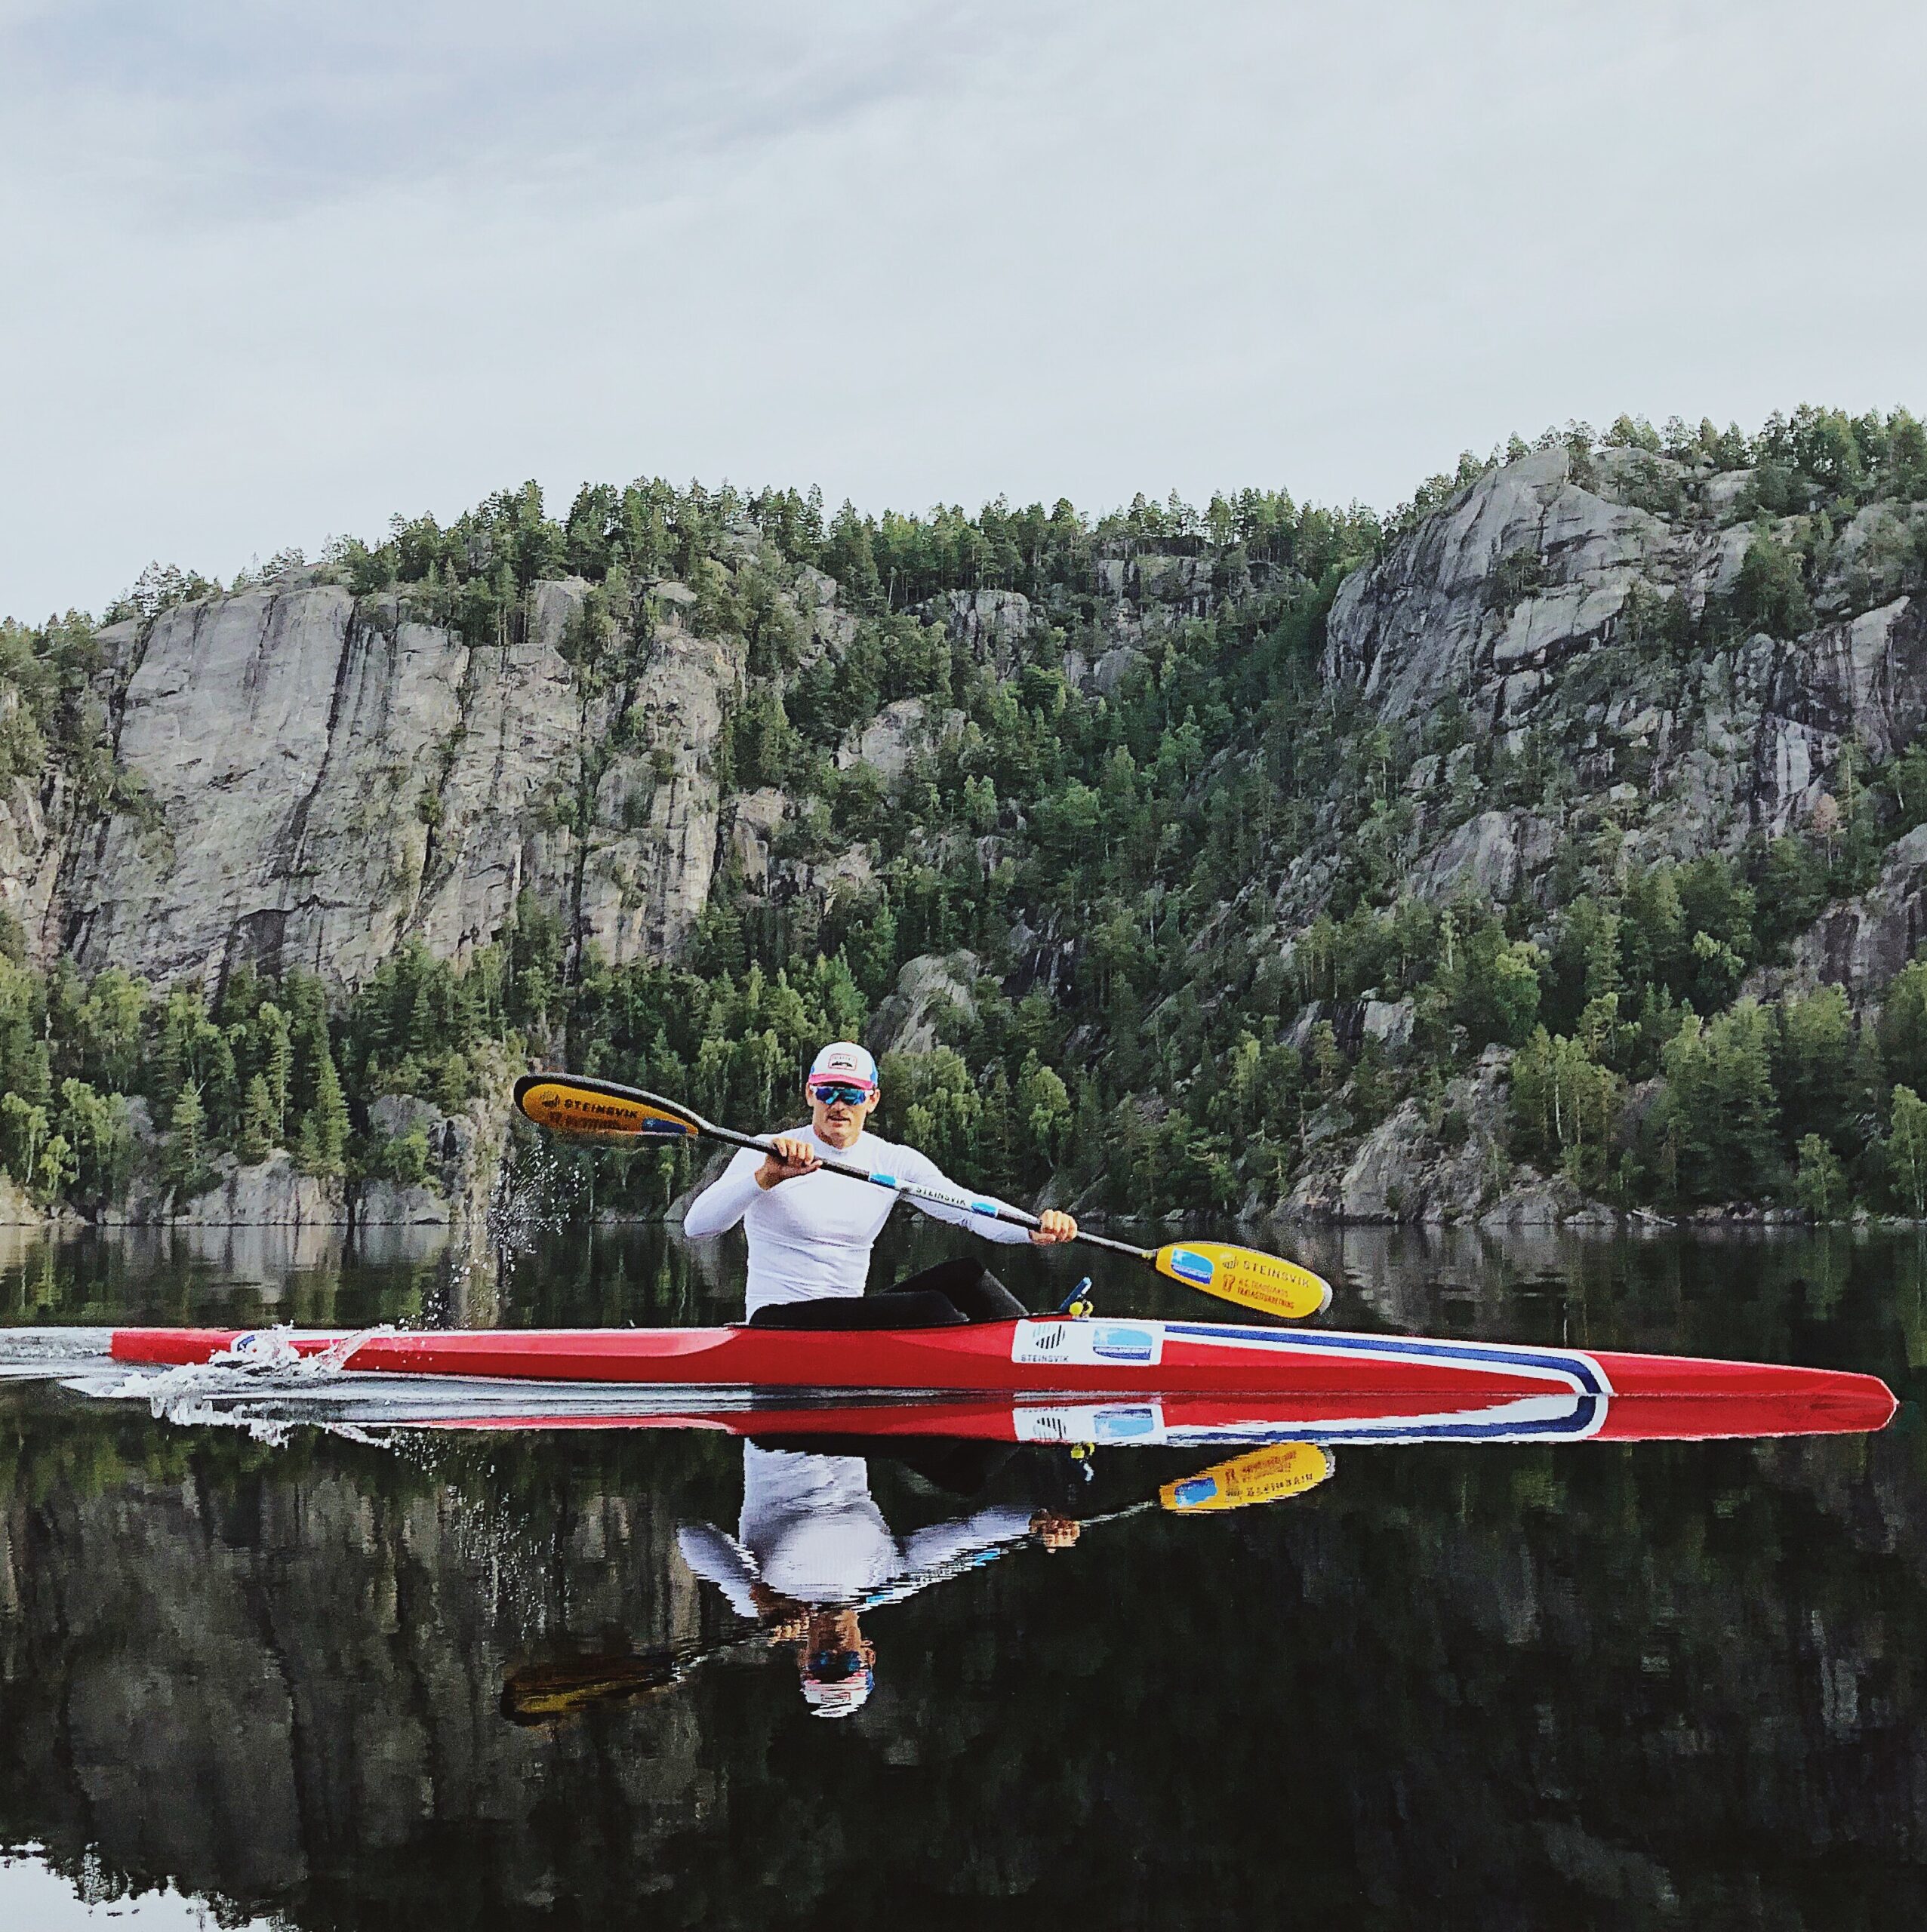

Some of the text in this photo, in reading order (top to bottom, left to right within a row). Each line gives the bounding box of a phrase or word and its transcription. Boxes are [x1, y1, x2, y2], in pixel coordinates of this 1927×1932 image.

[564, 1098, 639, 1118] STEINSVIK
[916, 1186, 966, 1206] STEINSVIK
[1243, 1260, 1310, 1288] STEINSVIK
[1020, 1354, 1069, 1362] STEINSVIK
